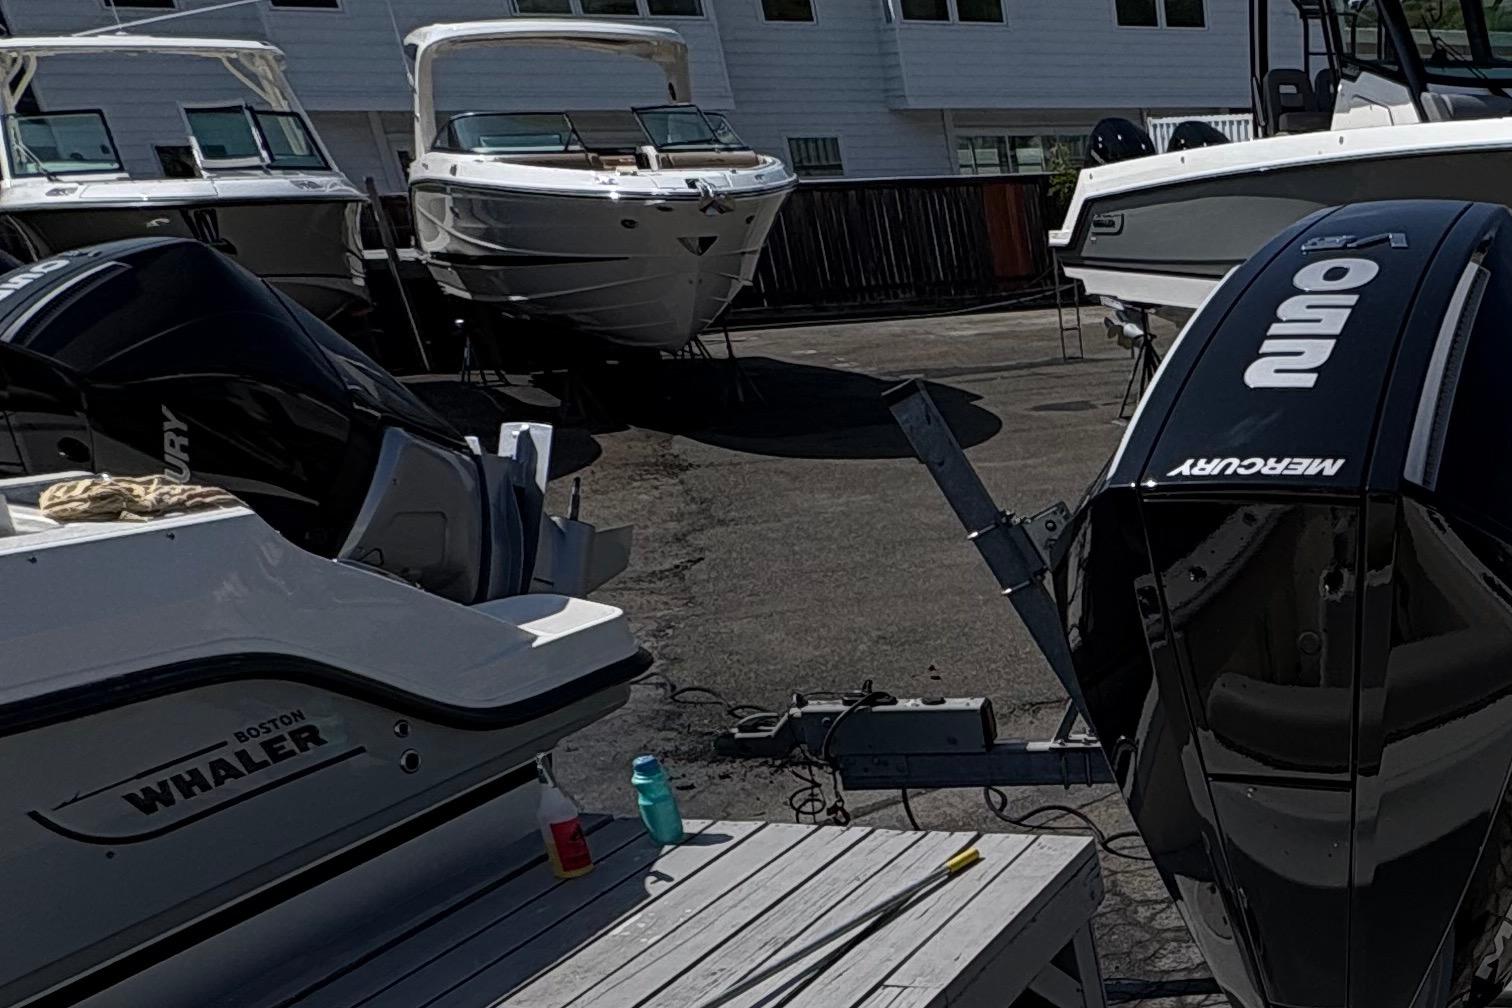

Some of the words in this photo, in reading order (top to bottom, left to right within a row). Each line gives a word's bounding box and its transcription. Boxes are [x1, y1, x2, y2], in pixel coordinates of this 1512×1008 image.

[1243, 257, 1380, 389] 250
[1166, 457, 1346, 477] MERCURY
[233, 709, 306, 743] BOSTON
[121, 724, 329, 816] WHALER
